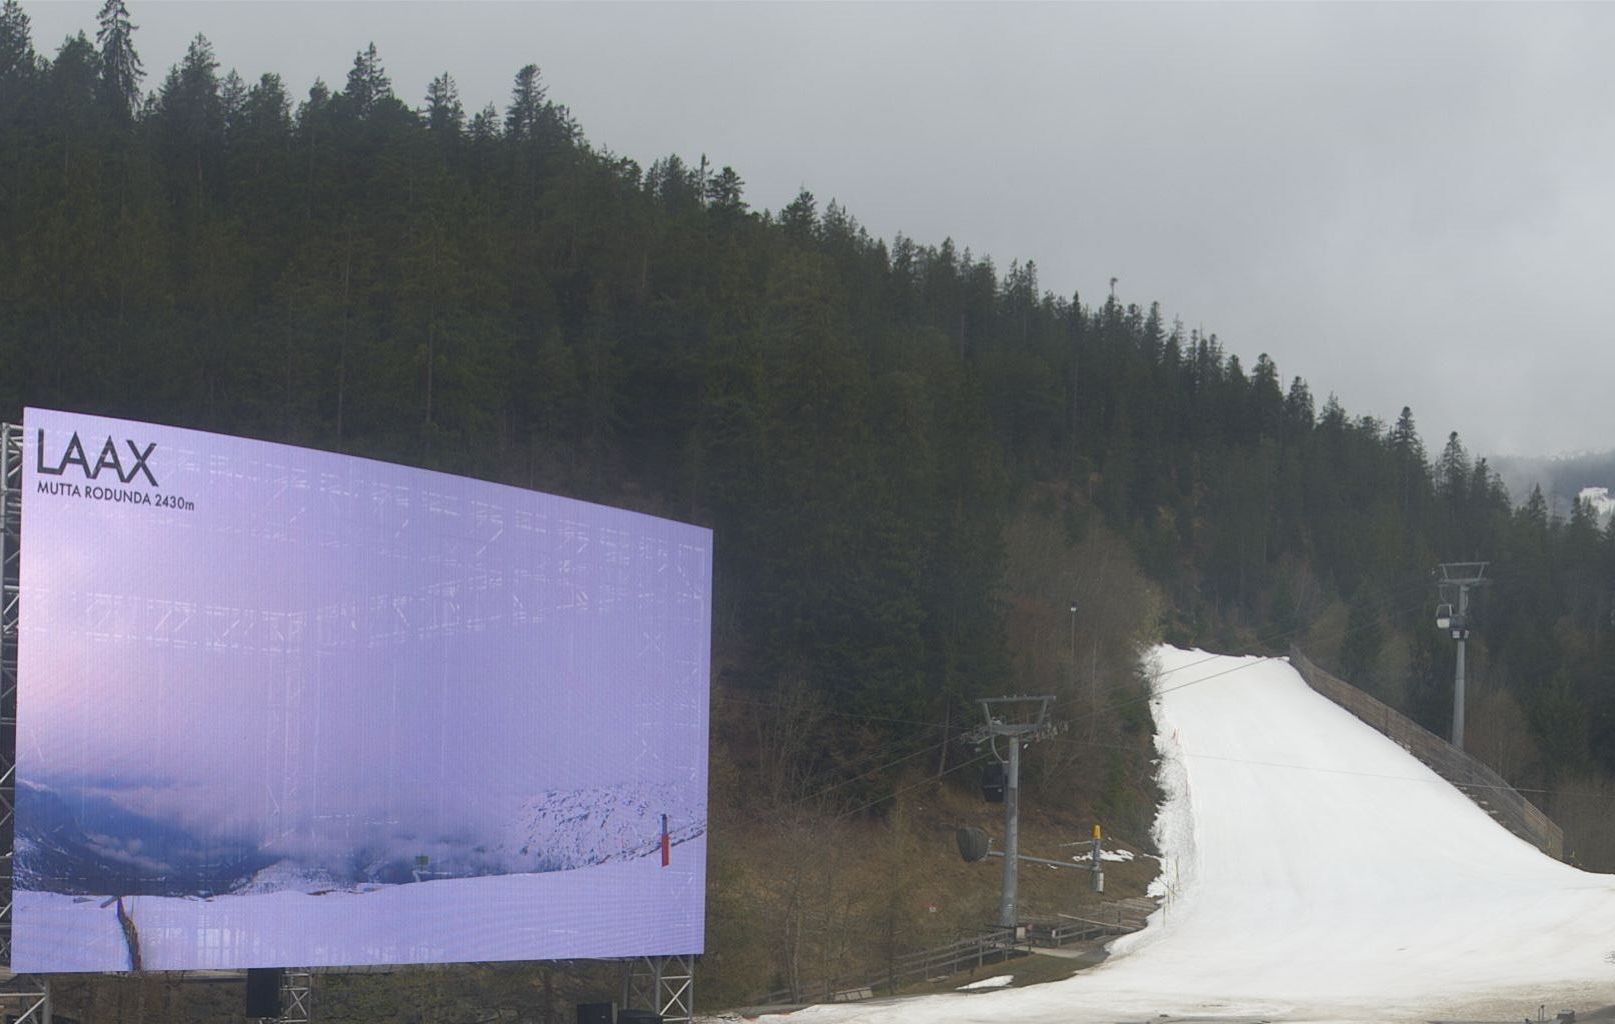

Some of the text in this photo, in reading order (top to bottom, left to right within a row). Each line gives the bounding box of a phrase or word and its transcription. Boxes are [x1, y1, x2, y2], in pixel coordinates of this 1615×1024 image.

[37, 428, 159, 487] LAAX
[37, 480, 195, 511] MUTTA RODUNDA 2430m
